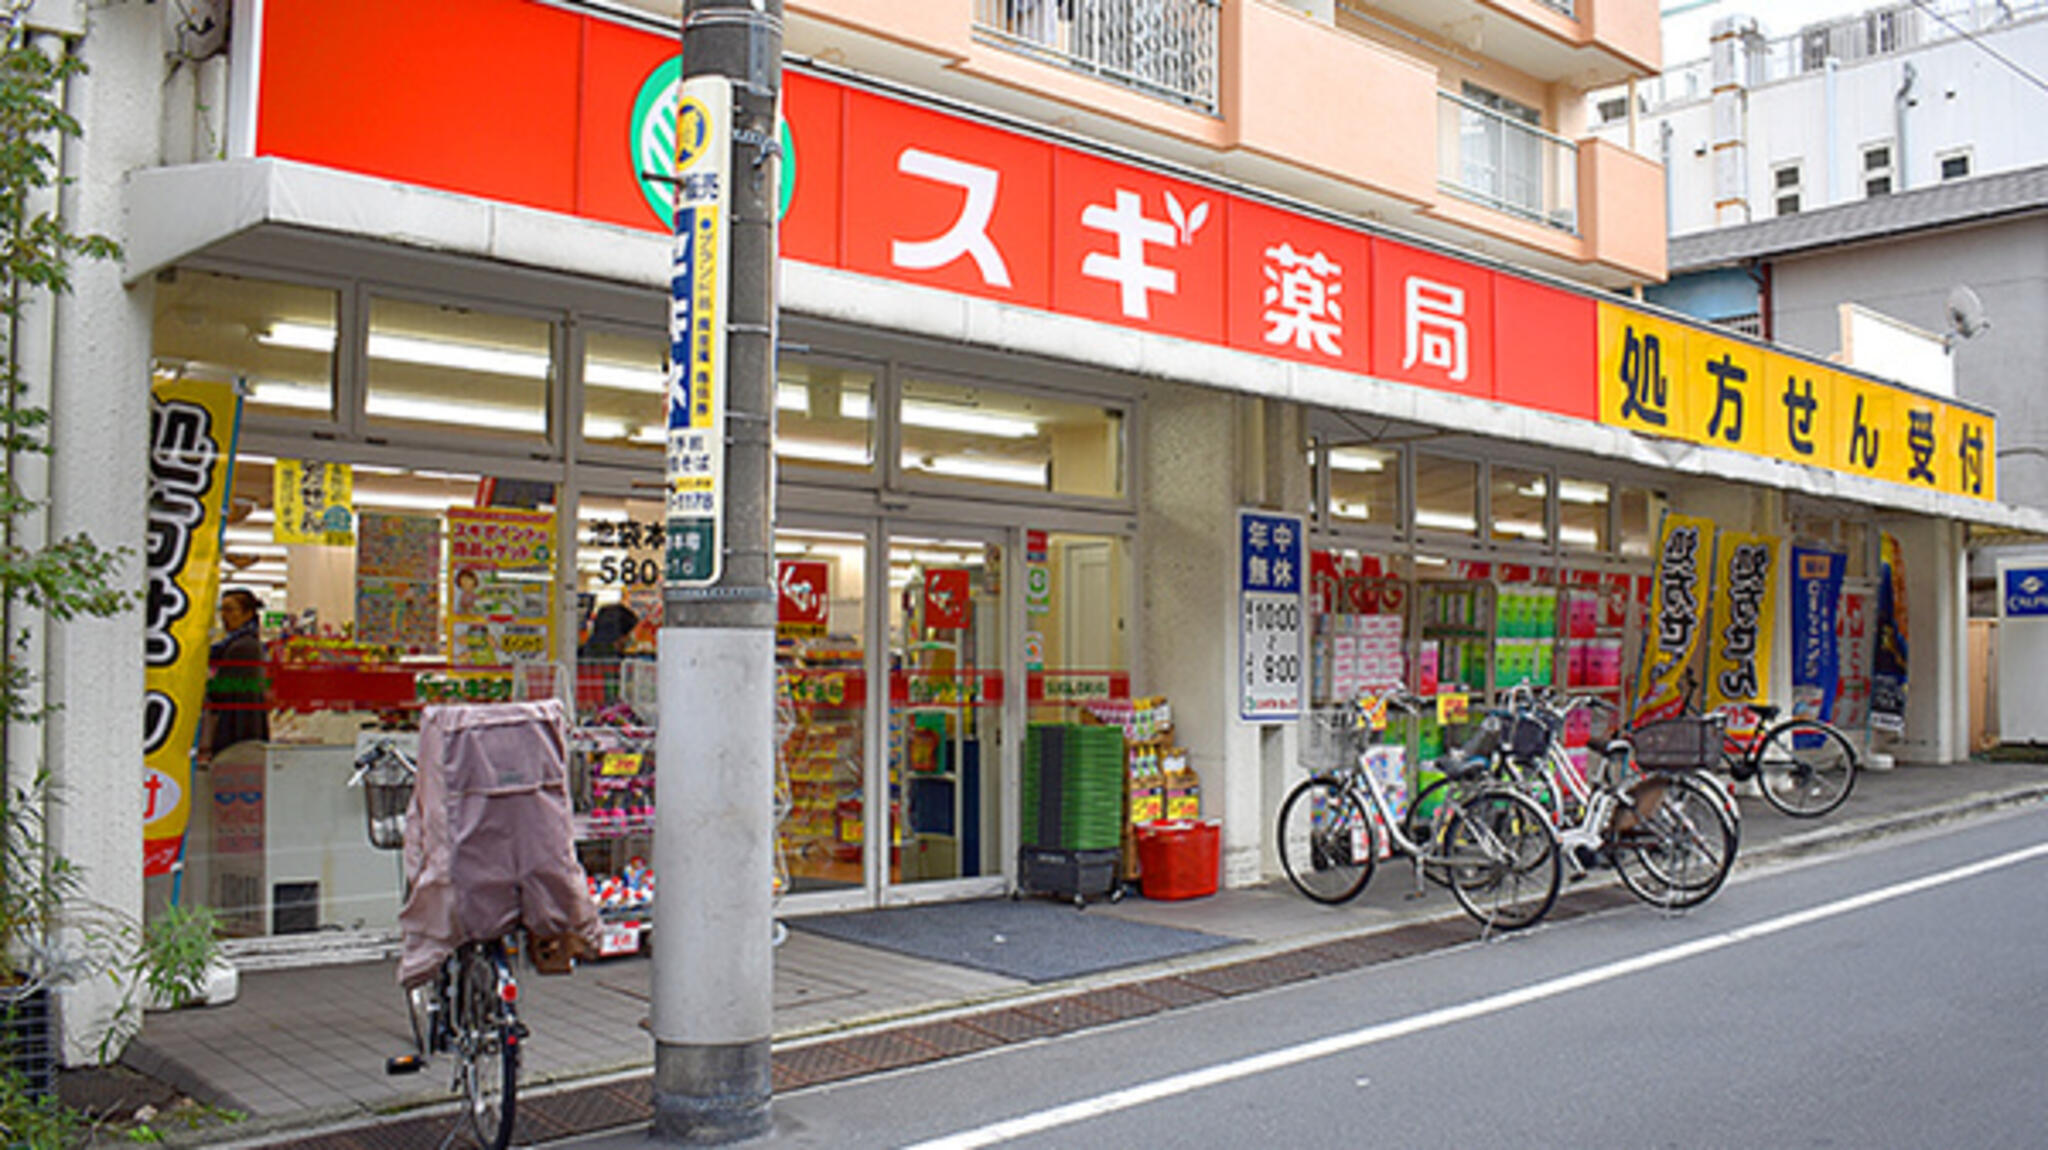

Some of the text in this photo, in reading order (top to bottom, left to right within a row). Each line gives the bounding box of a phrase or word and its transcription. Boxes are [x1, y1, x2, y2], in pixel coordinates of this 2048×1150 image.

[892, 148, 1468, 382] スギ薬局
[1619, 325, 1985, 495] 処方せん受付
[1249, 521, 1293, 552] 年中
[1249, 556, 1293, 587] 無休
